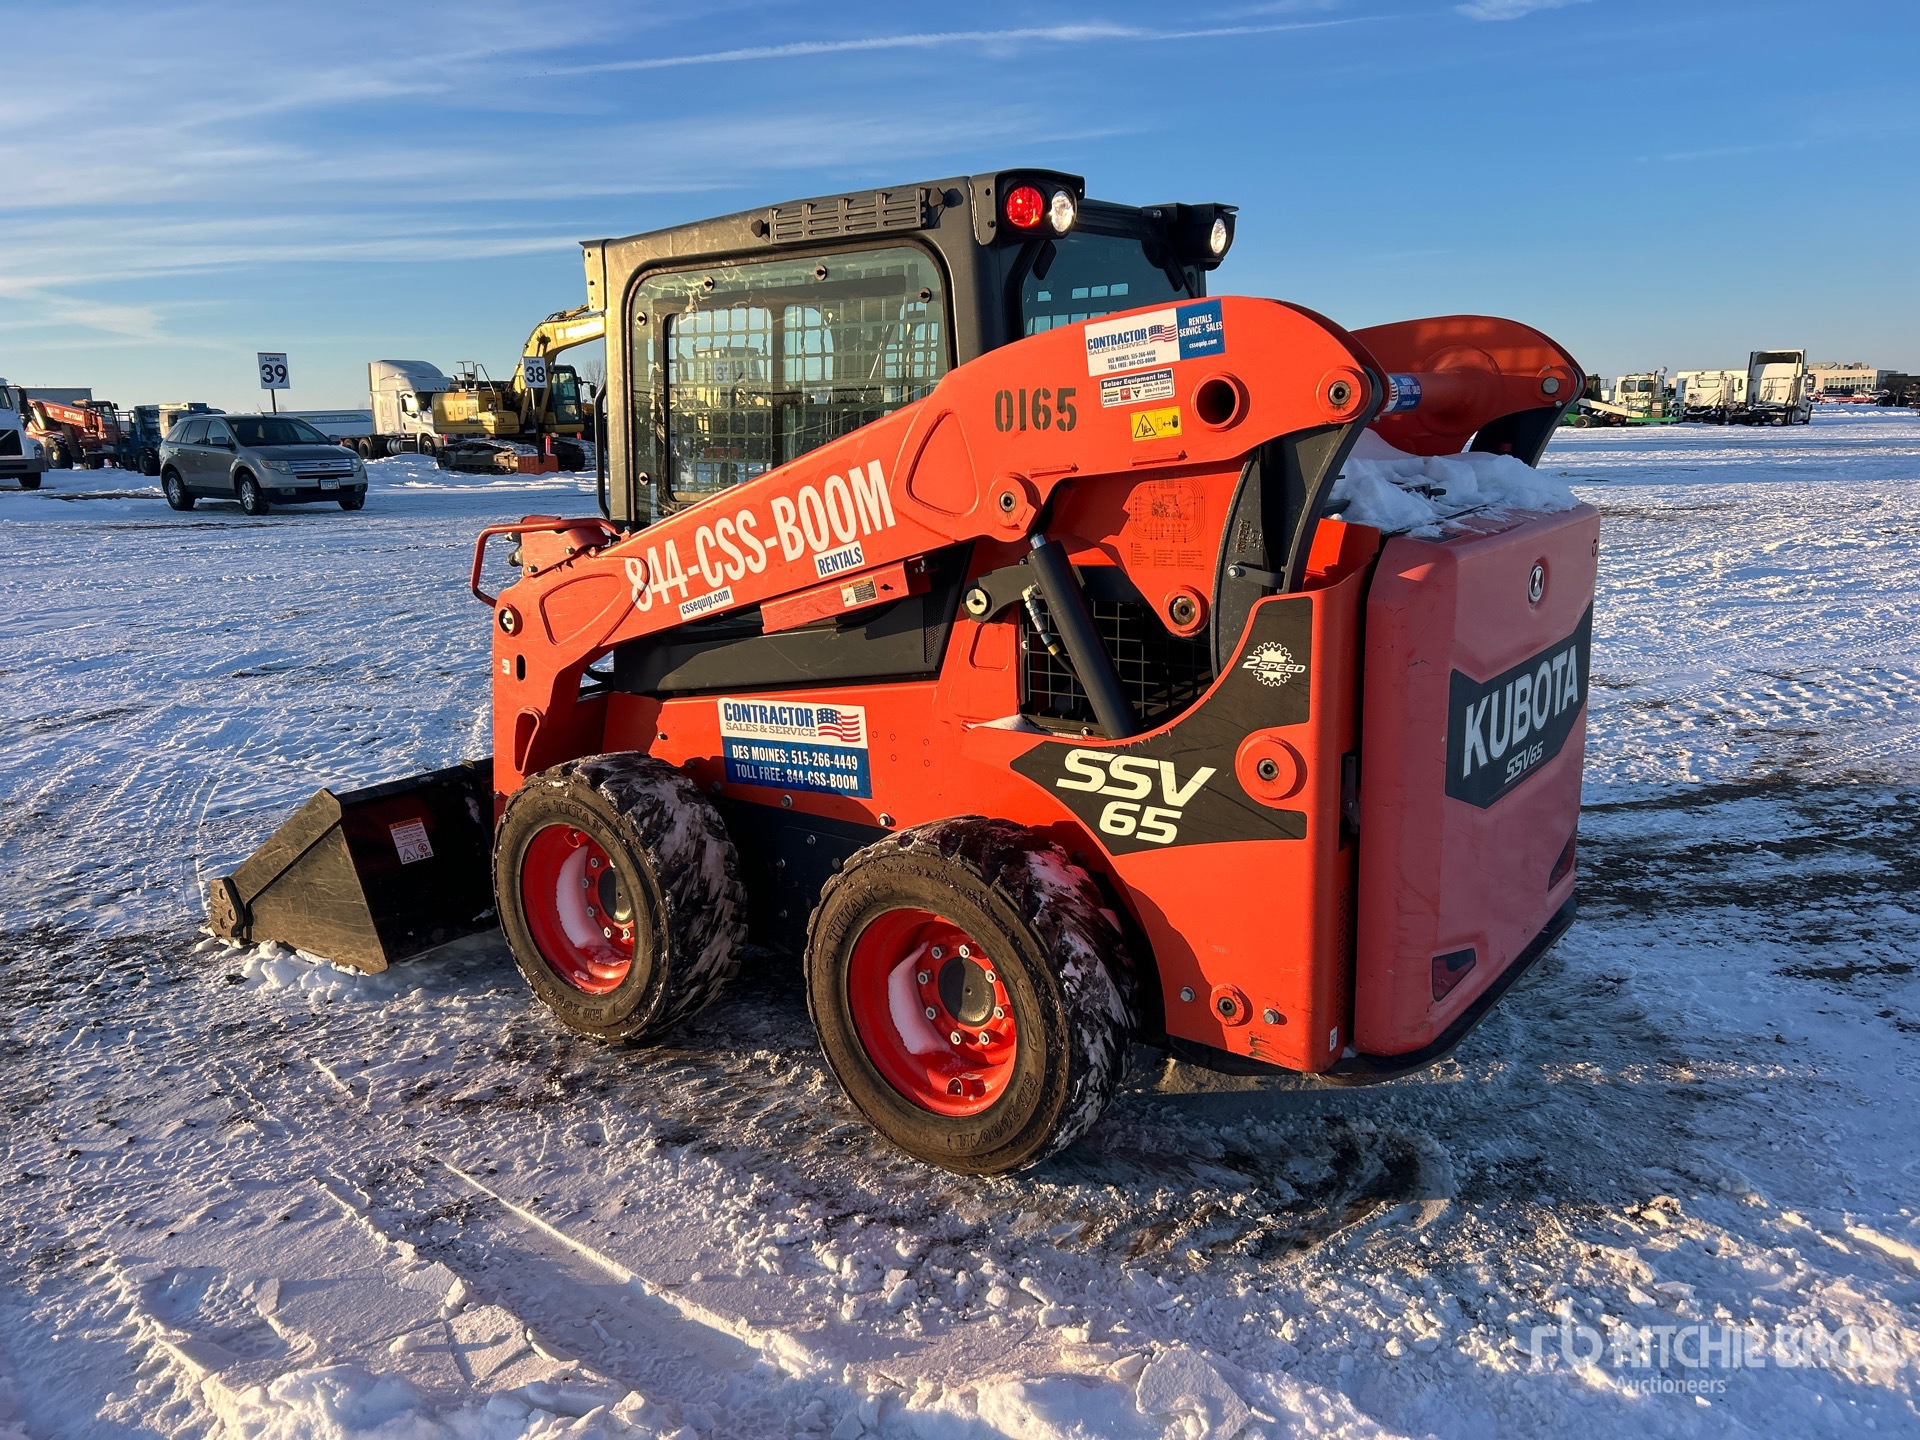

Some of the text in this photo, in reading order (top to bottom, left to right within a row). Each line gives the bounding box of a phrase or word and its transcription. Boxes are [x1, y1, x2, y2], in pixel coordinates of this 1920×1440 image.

[1179, 325, 1202, 337] SERVICE
[1206, 321, 1223, 332] SALES
[1188, 314, 1213, 326] RENTALS
[1088, 328, 1147, 350] CONTRACTOR
[1089, 346, 1110, 356] SALES
[1117, 340, 1148, 351] SERVICE
[262, 364, 287, 383] 39
[526, 366, 546, 383] 38
[1124, 374, 1156, 385] Equipment
[1157, 372, 1170, 380] Inc.
[995, 388, 1077, 432] 0165
[625, 459, 896, 612] 844-CSS-BOOM
[818, 547, 863, 575] RENTALS
[682, 589, 730, 614] cssequip.com
[723, 702, 815, 728] CONTRACTOR
[1462, 644, 1579, 780] KUBOTA
[726, 722, 817, 737] SALES & SERVICE
[732, 744, 858, 771] DES MOINES: 515-266-4449
[1504, 741, 1544, 784] SSV65
[736, 763, 859, 790] TOLL FREE: 844-CSS-BOOM
[1056, 748, 1217, 807] SSV
[1099, 801, 1183, 844] 65
[827, 886, 877, 945] TITAN
